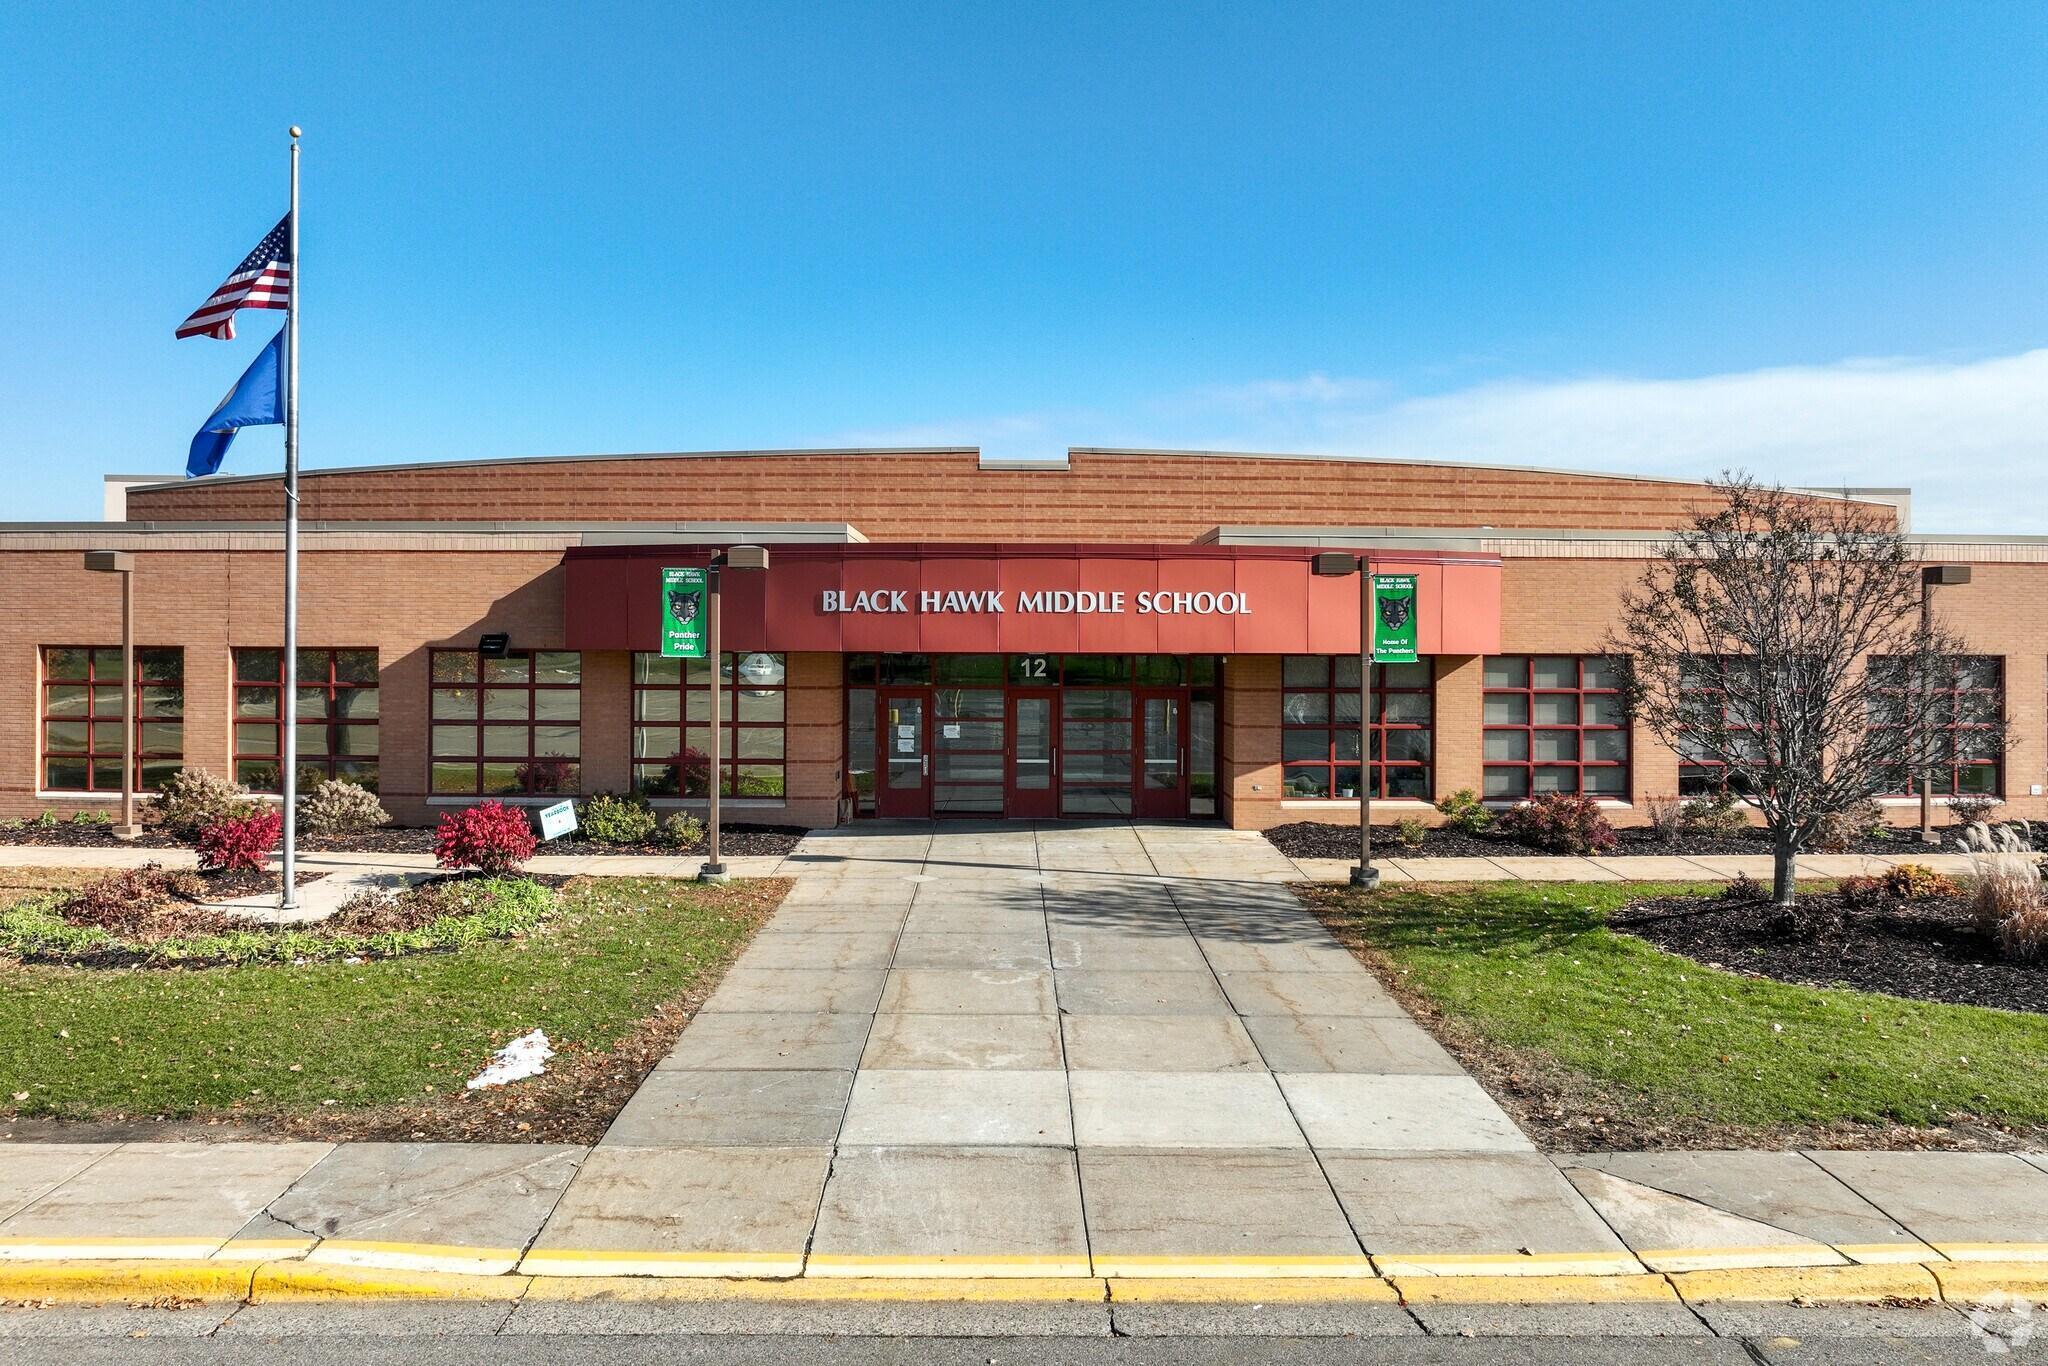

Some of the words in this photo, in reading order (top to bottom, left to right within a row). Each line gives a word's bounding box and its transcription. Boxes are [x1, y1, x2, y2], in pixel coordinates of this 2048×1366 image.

[822, 590, 909, 613] BLACK
[920, 590, 1006, 613] HAWK
[1017, 591, 1126, 614] MIDDLE
[1136, 591, 1253, 615] SCHOOL
[669, 630, 700, 639] Panther
[673, 642, 695, 650] Pride
[1021, 658, 1047, 678] 12
